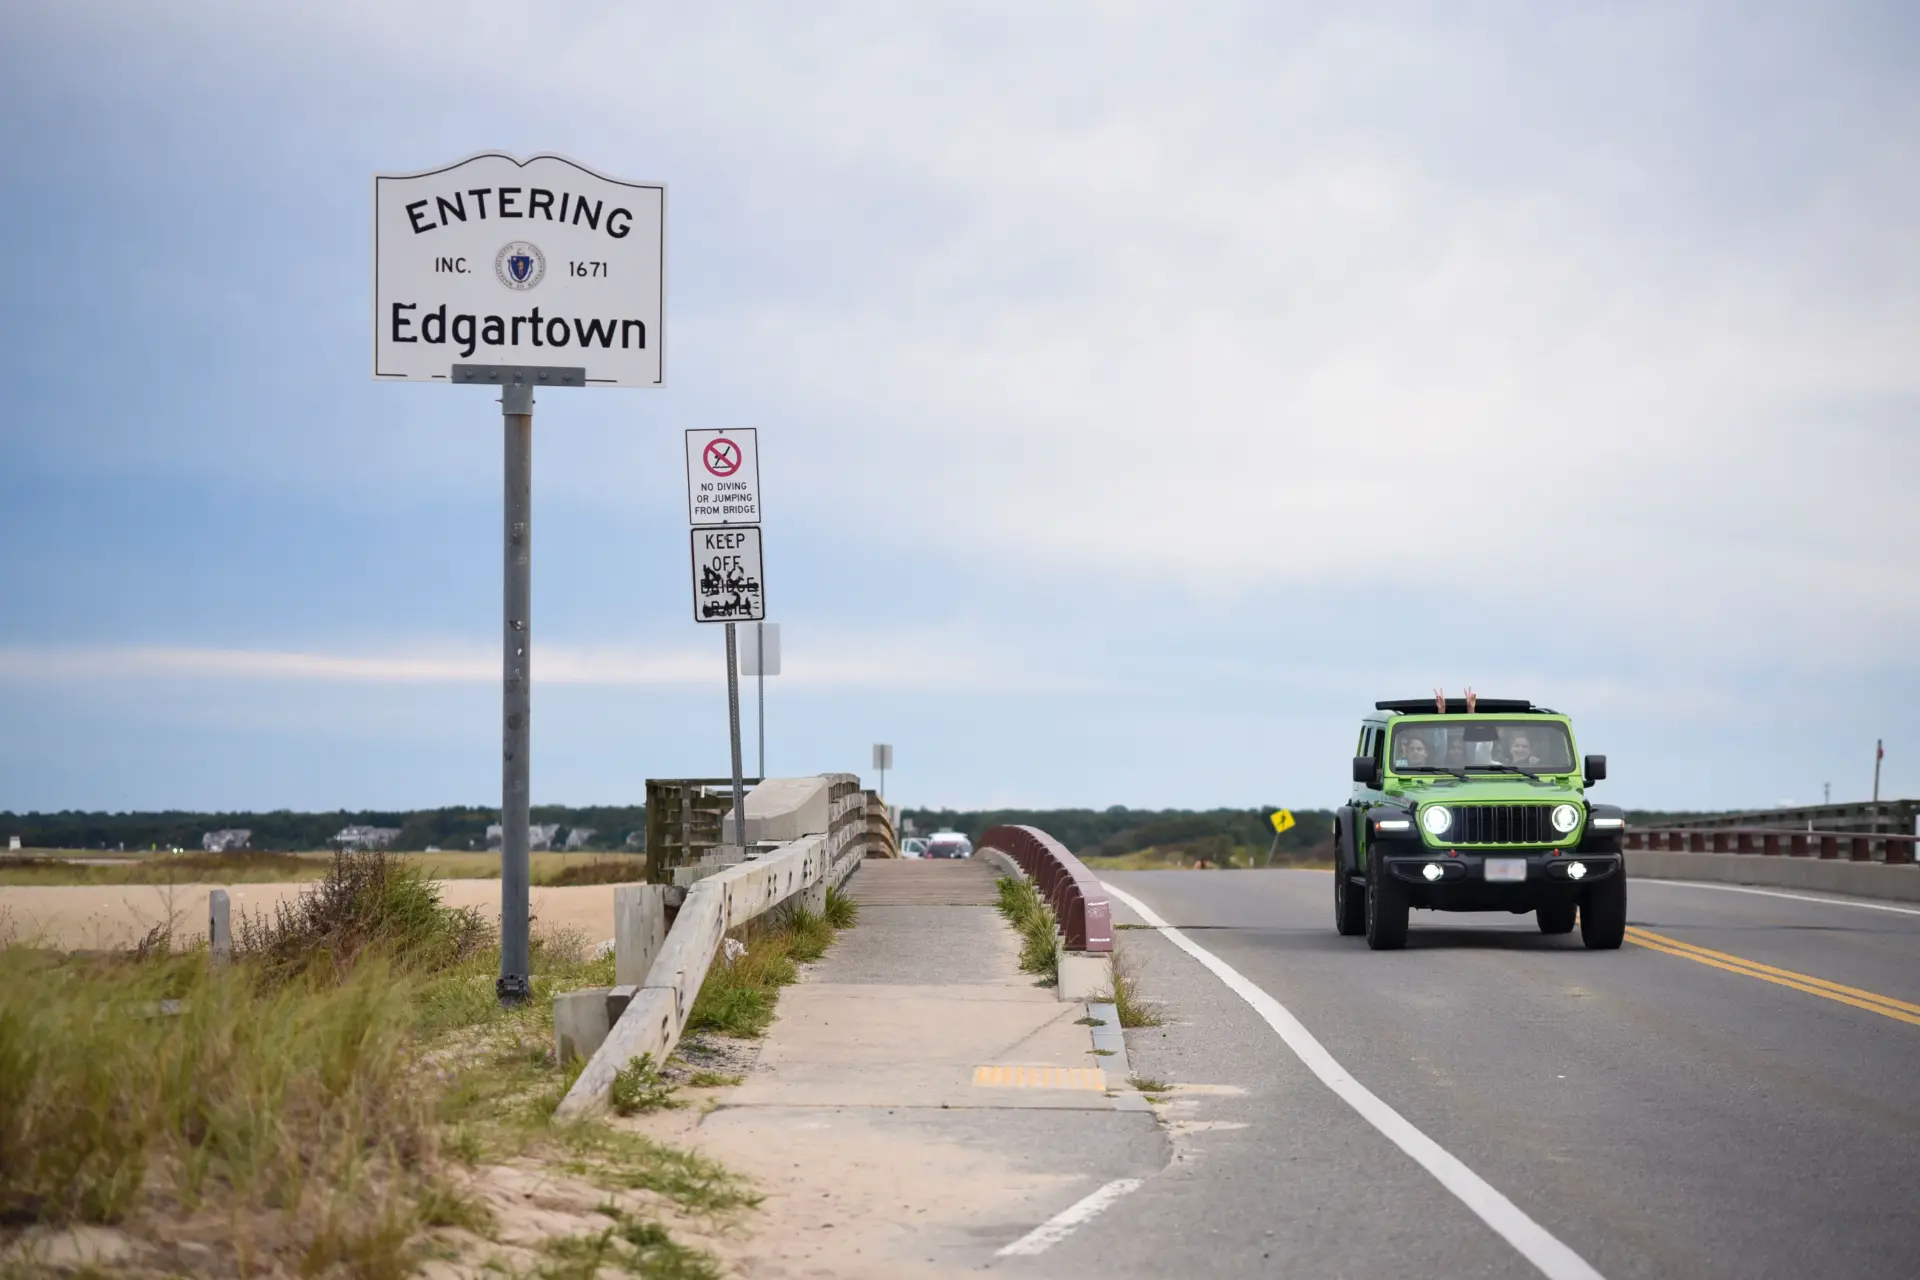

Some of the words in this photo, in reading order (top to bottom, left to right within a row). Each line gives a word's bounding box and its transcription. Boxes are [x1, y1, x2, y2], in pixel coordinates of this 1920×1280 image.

[405, 187, 633, 239] ENTERING
[435, 257, 471, 274] INC.
[569, 261, 608, 278] 1671
[392, 302, 646, 358] Edgartown
[701, 483, 713, 491] NO
[717, 482, 747, 491] DIVING
[696, 494, 709, 503] OR
[712, 494, 752, 502] JUMPING
[695, 506, 720, 514] FROM
[723, 505, 756, 514] BRIDGE
[706, 533, 745, 549] KEEP
[712, 555, 741, 572] OFF
